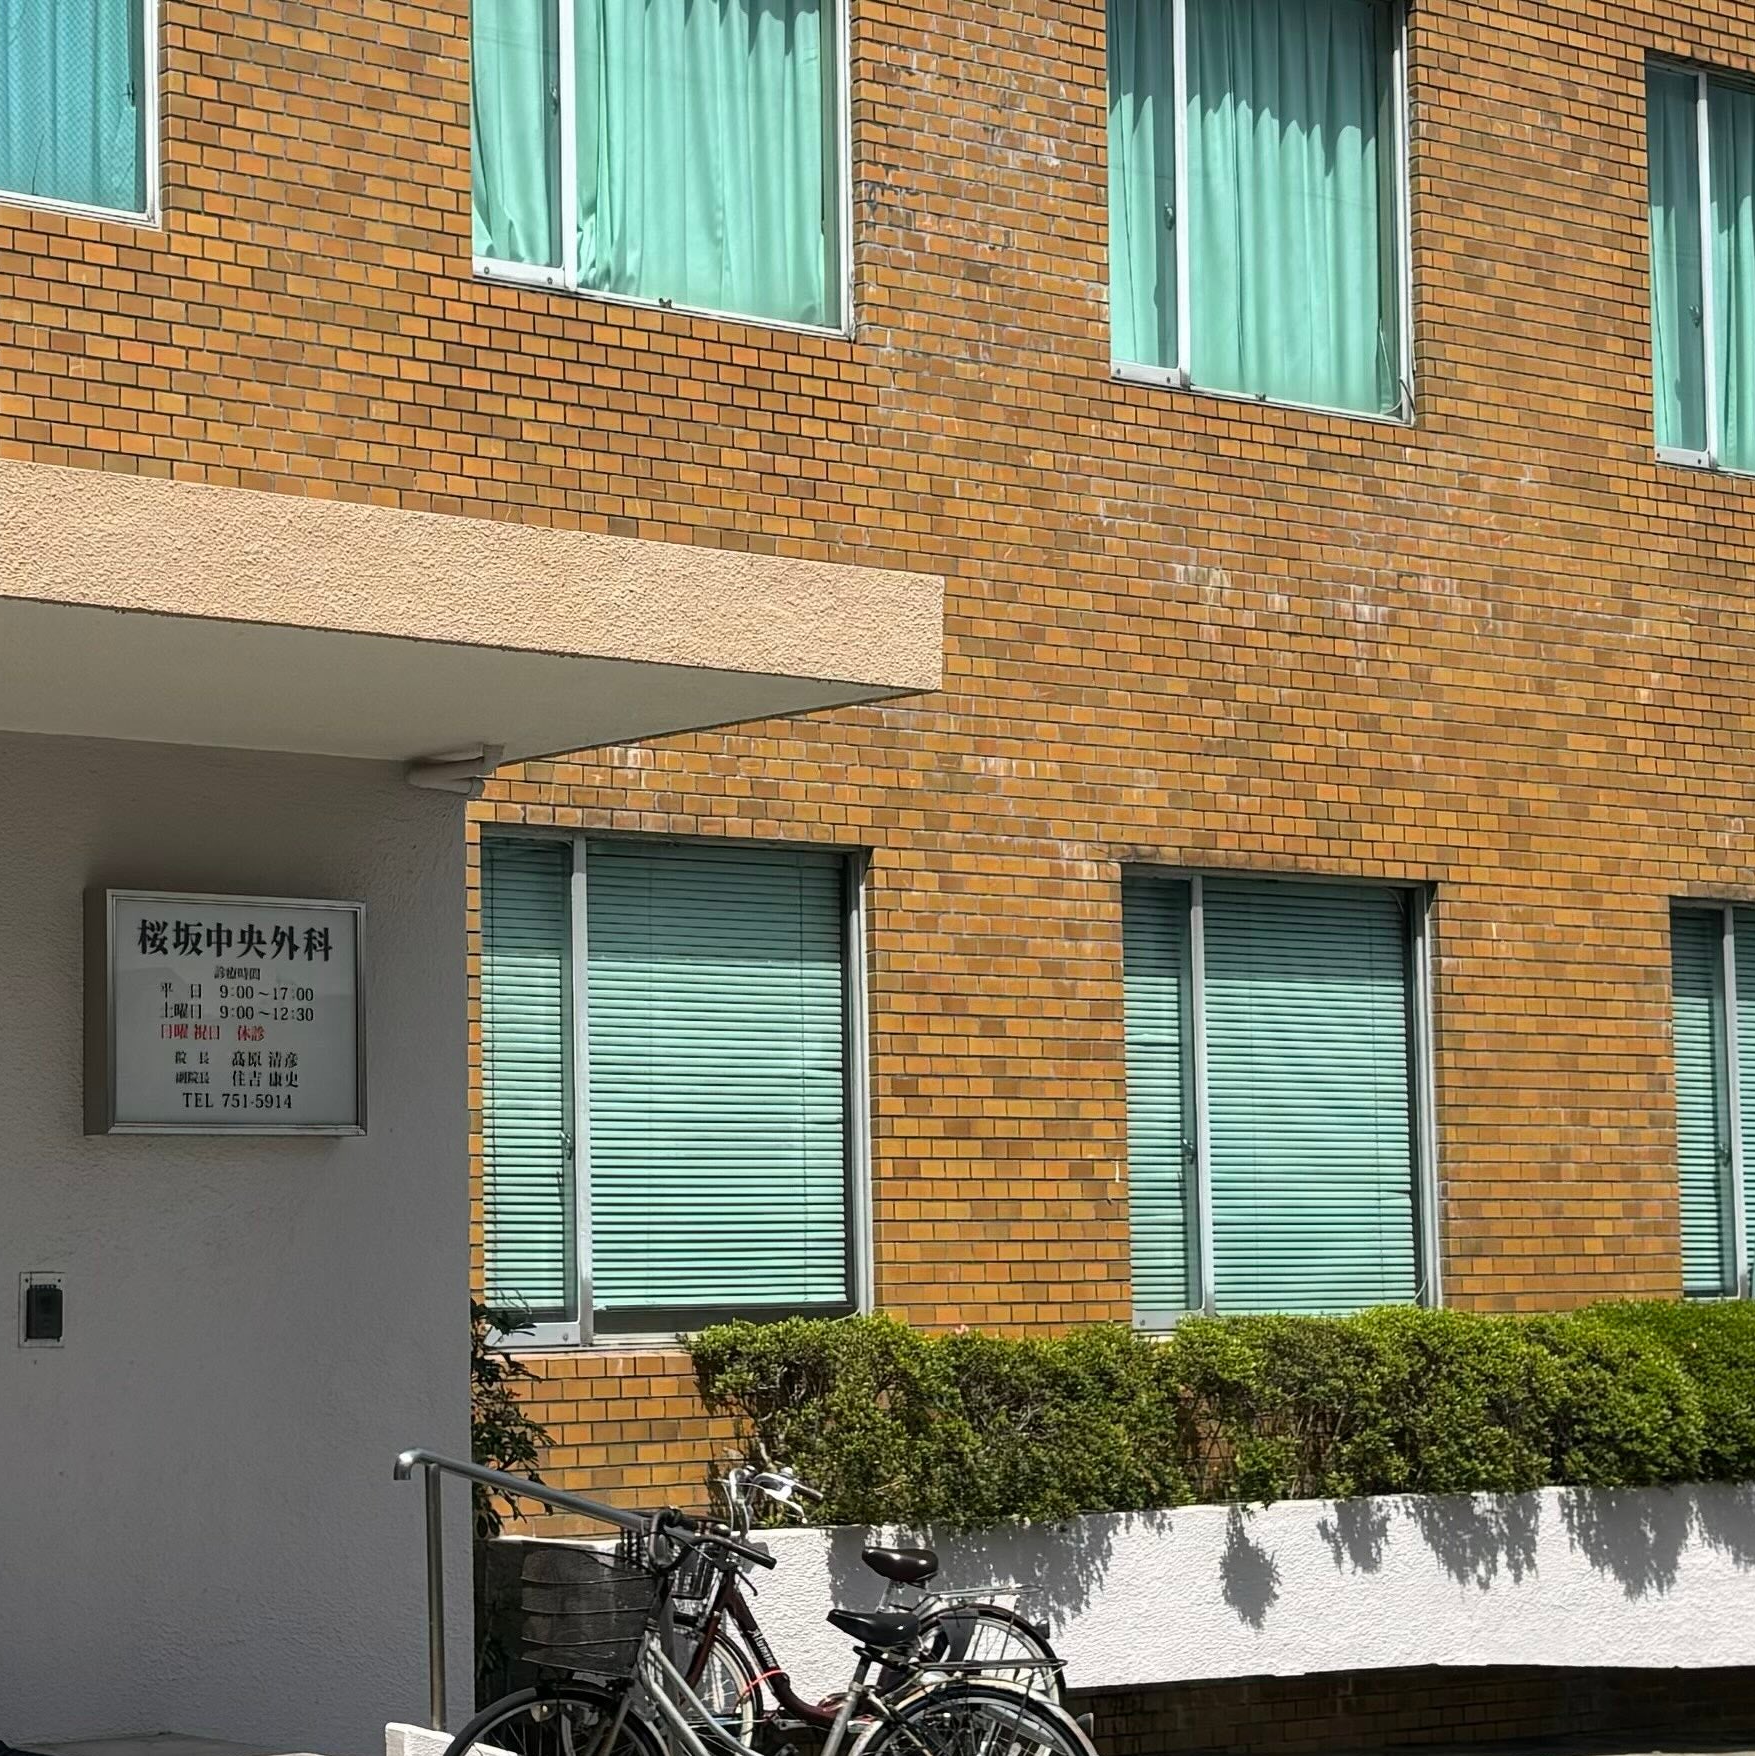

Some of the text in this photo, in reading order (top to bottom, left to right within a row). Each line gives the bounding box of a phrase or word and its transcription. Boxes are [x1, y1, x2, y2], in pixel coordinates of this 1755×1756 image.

[138, 919, 333, 961] 桜坂中央外科
[183, 1093, 292, 1109] TEL 751-5914
